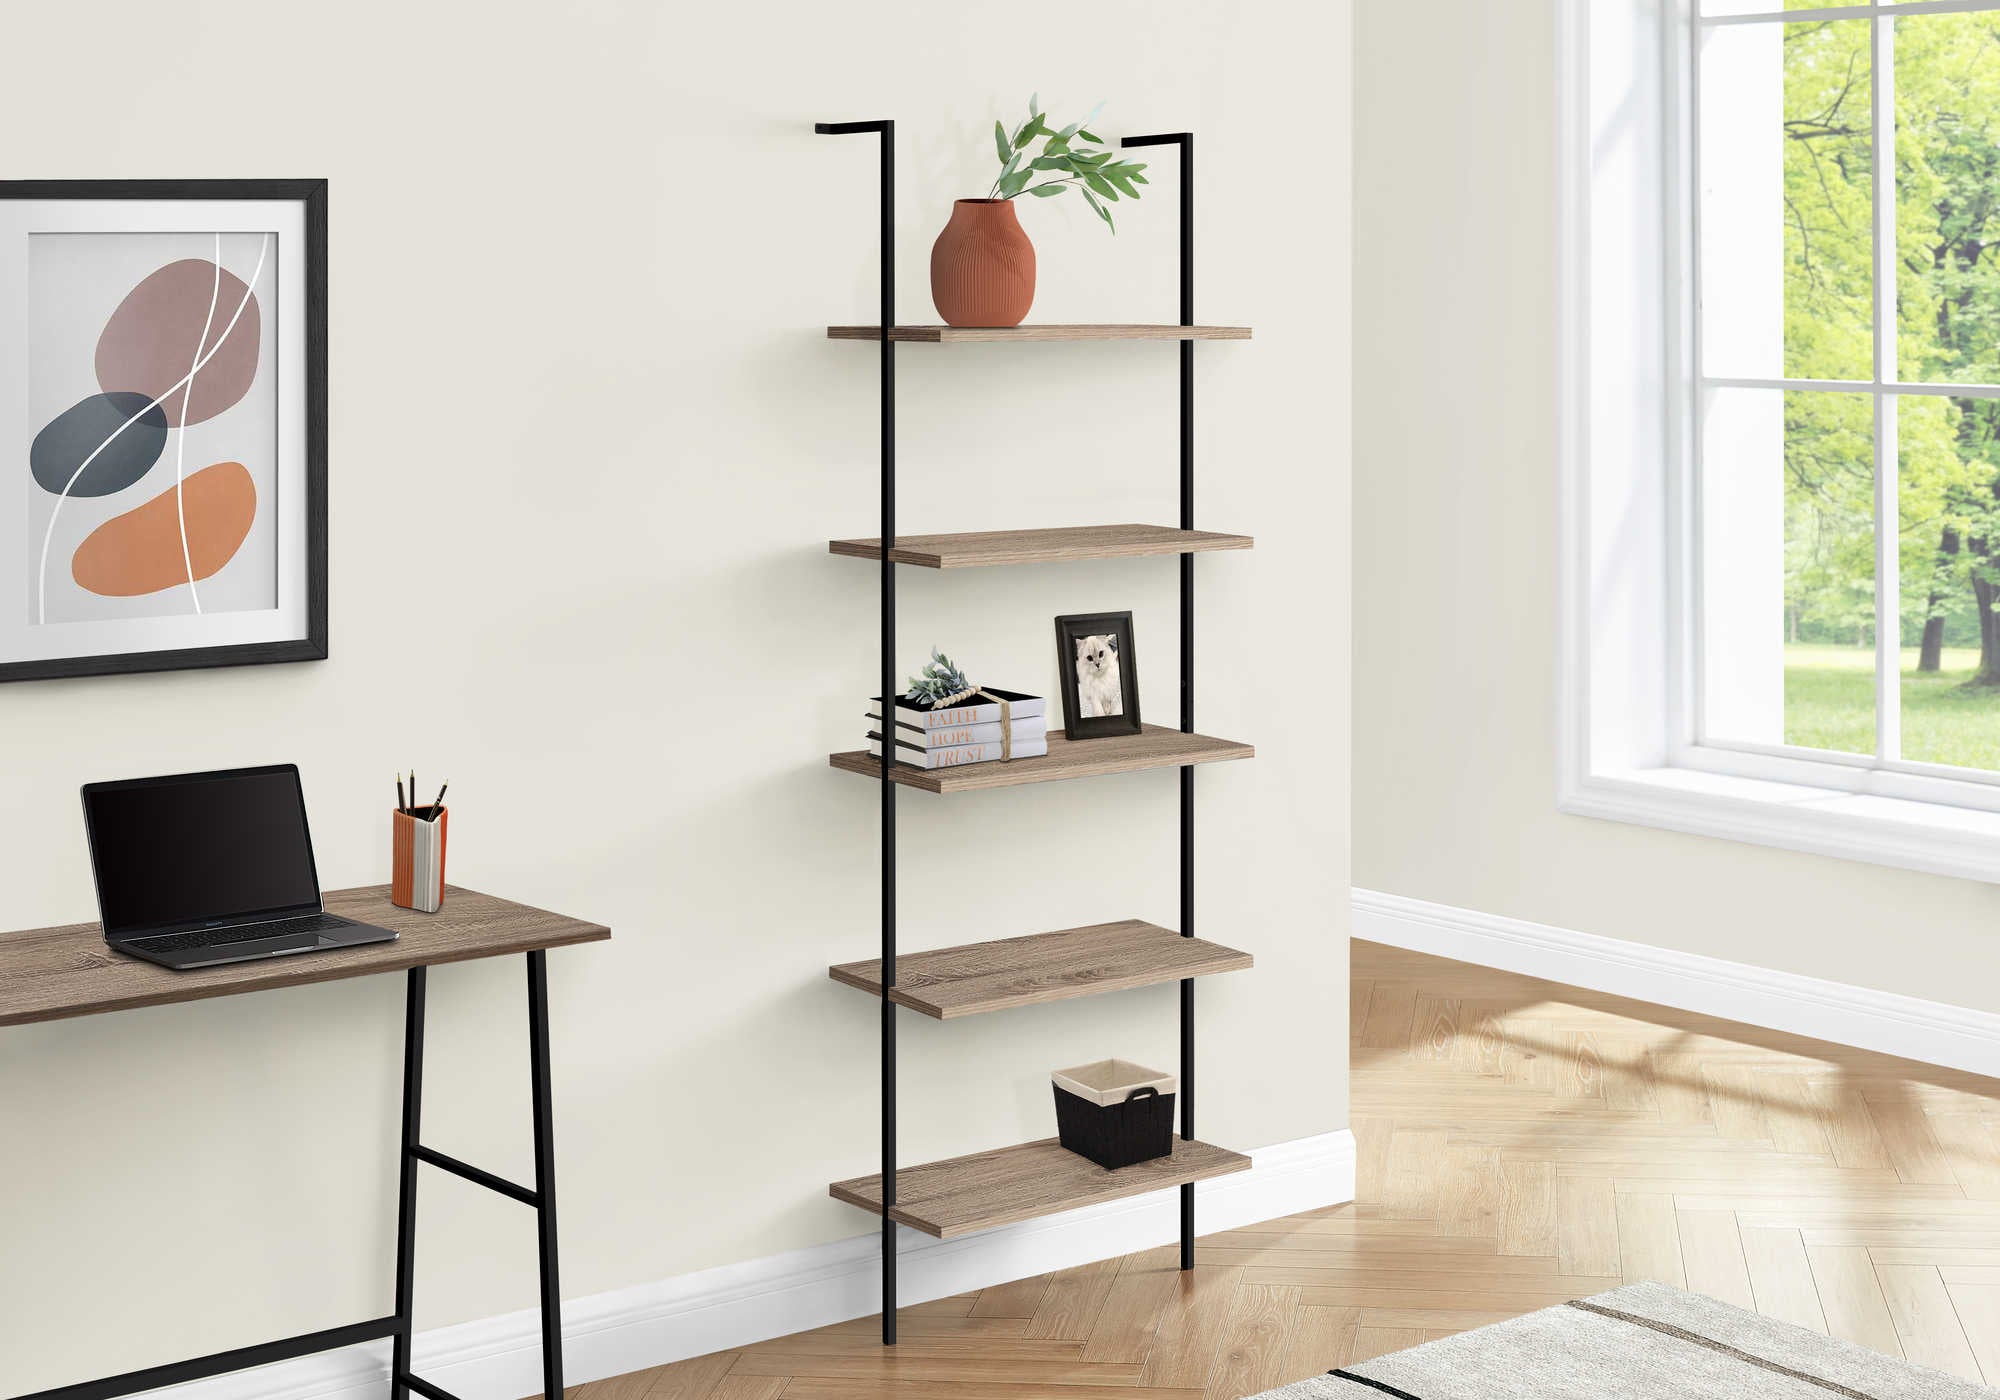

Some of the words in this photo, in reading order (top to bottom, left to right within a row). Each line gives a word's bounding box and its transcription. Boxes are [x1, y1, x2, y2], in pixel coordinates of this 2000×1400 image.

[928, 708, 977, 728] FAITH
[931, 728, 975, 746] HOPE
[935, 745, 985, 768] TRUST
